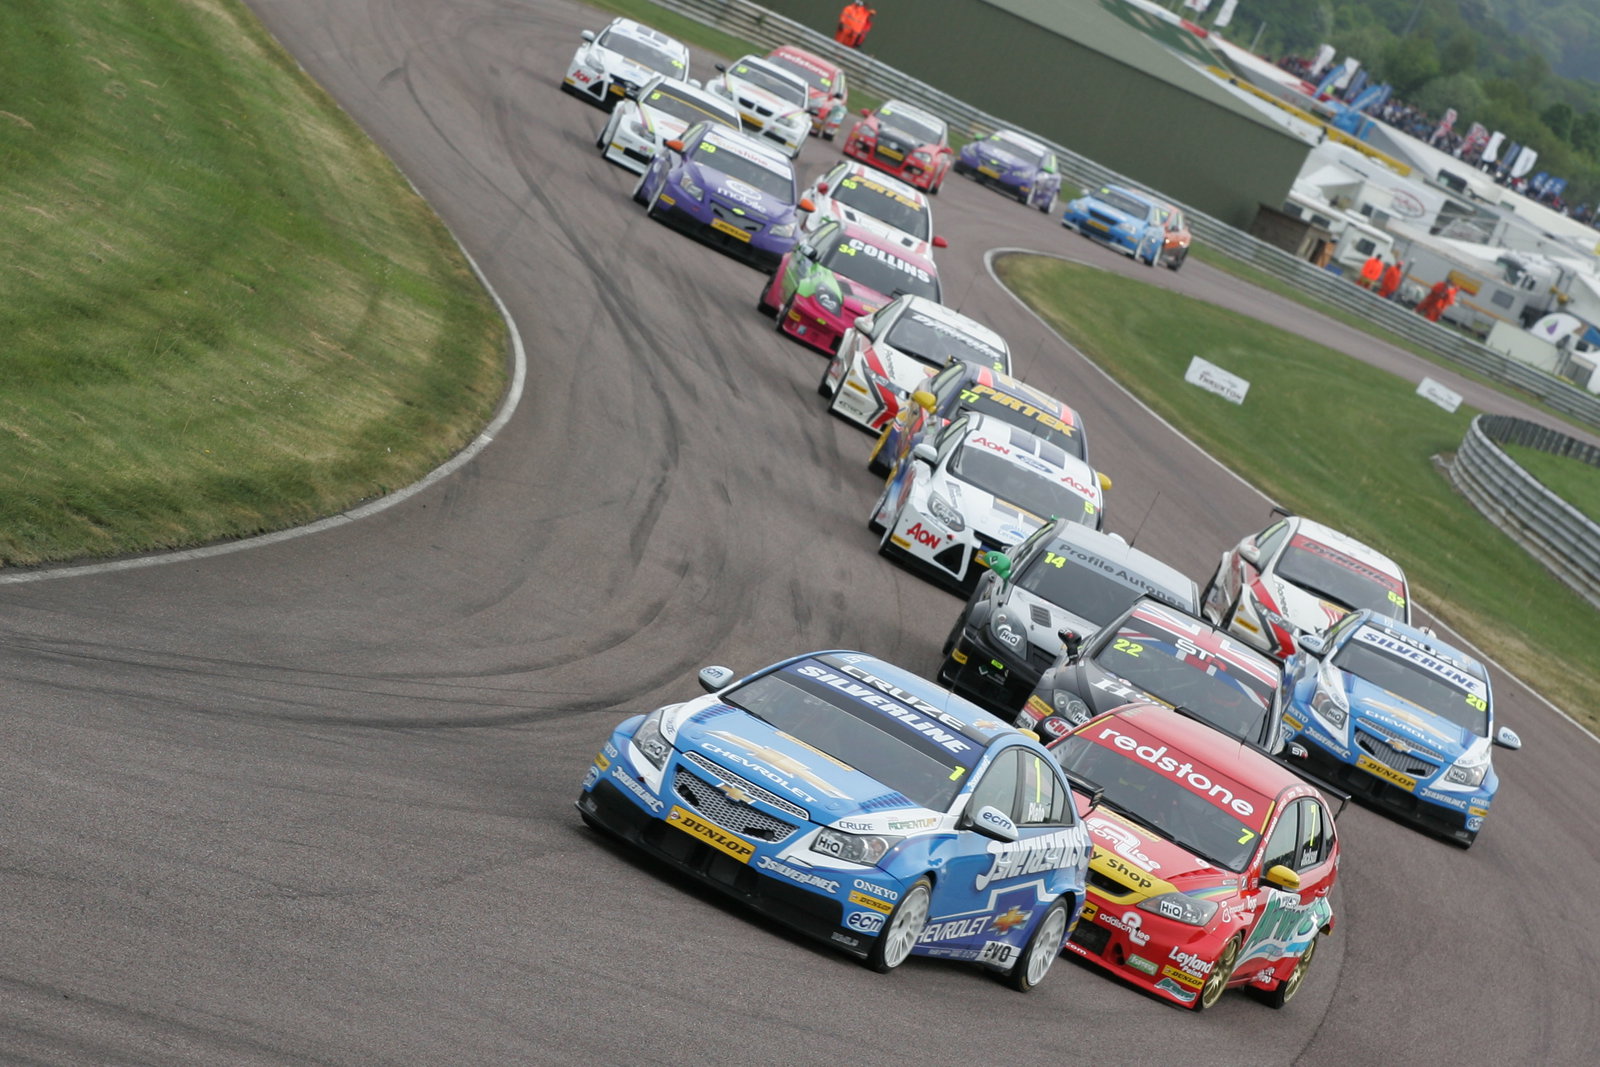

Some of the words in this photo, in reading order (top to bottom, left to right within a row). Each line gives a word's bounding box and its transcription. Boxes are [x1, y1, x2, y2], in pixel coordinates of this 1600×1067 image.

[838, 244, 857, 257] 34
[849, 238, 930, 283] COLLINS
[959, 389, 980, 404] 77
[971, 384, 1077, 437] PIRTEK
[972, 437, 1011, 455] AON
[1061, 475, 1096, 498] AON
[1084, 501, 1095, 515] 5
[906, 523, 941, 550] AON
[1044, 552, 1067, 568] 14
[1059, 544, 1114, 573] Profile
[1113, 638, 1144, 657] 22
[1363, 632, 1480, 691] SILVERLINE
[841, 664, 966, 732] CRUZE
[1465, 693, 1487, 712] 20
[797, 664, 971, 755] SILVERLINE
[1365, 709, 1445, 751] CHEVROLET
[701, 741, 818, 803] CHEVROLET
[949, 766, 966, 781] 1
[1098, 727, 1254, 816] redstone
[1366, 761, 1416, 789] DUNLOP
[838, 820, 875, 832] CRUZE
[982, 810, 1013, 831] ecm
[682, 817, 750, 857] DUNLOP
[818, 835, 841, 853] HiQ
[1237, 828, 1255, 845] 7
[767, 860, 831, 891] SILVERLINE
[1106, 858, 1152, 888] Shop
[853, 879, 898, 901] ONKYO
[860, 896, 892, 911] DUNLOP
[1161, 902, 1181, 917] HiQ
[848, 912, 884, 933] ecm
[916, 916, 992, 944] HEVROLET
[1099, 912, 1132, 933] addison
[1168, 945, 1215, 974] Leyland
[1171, 971, 1203, 987] DUNLOP
[1182, 965, 1203, 979] Paints
